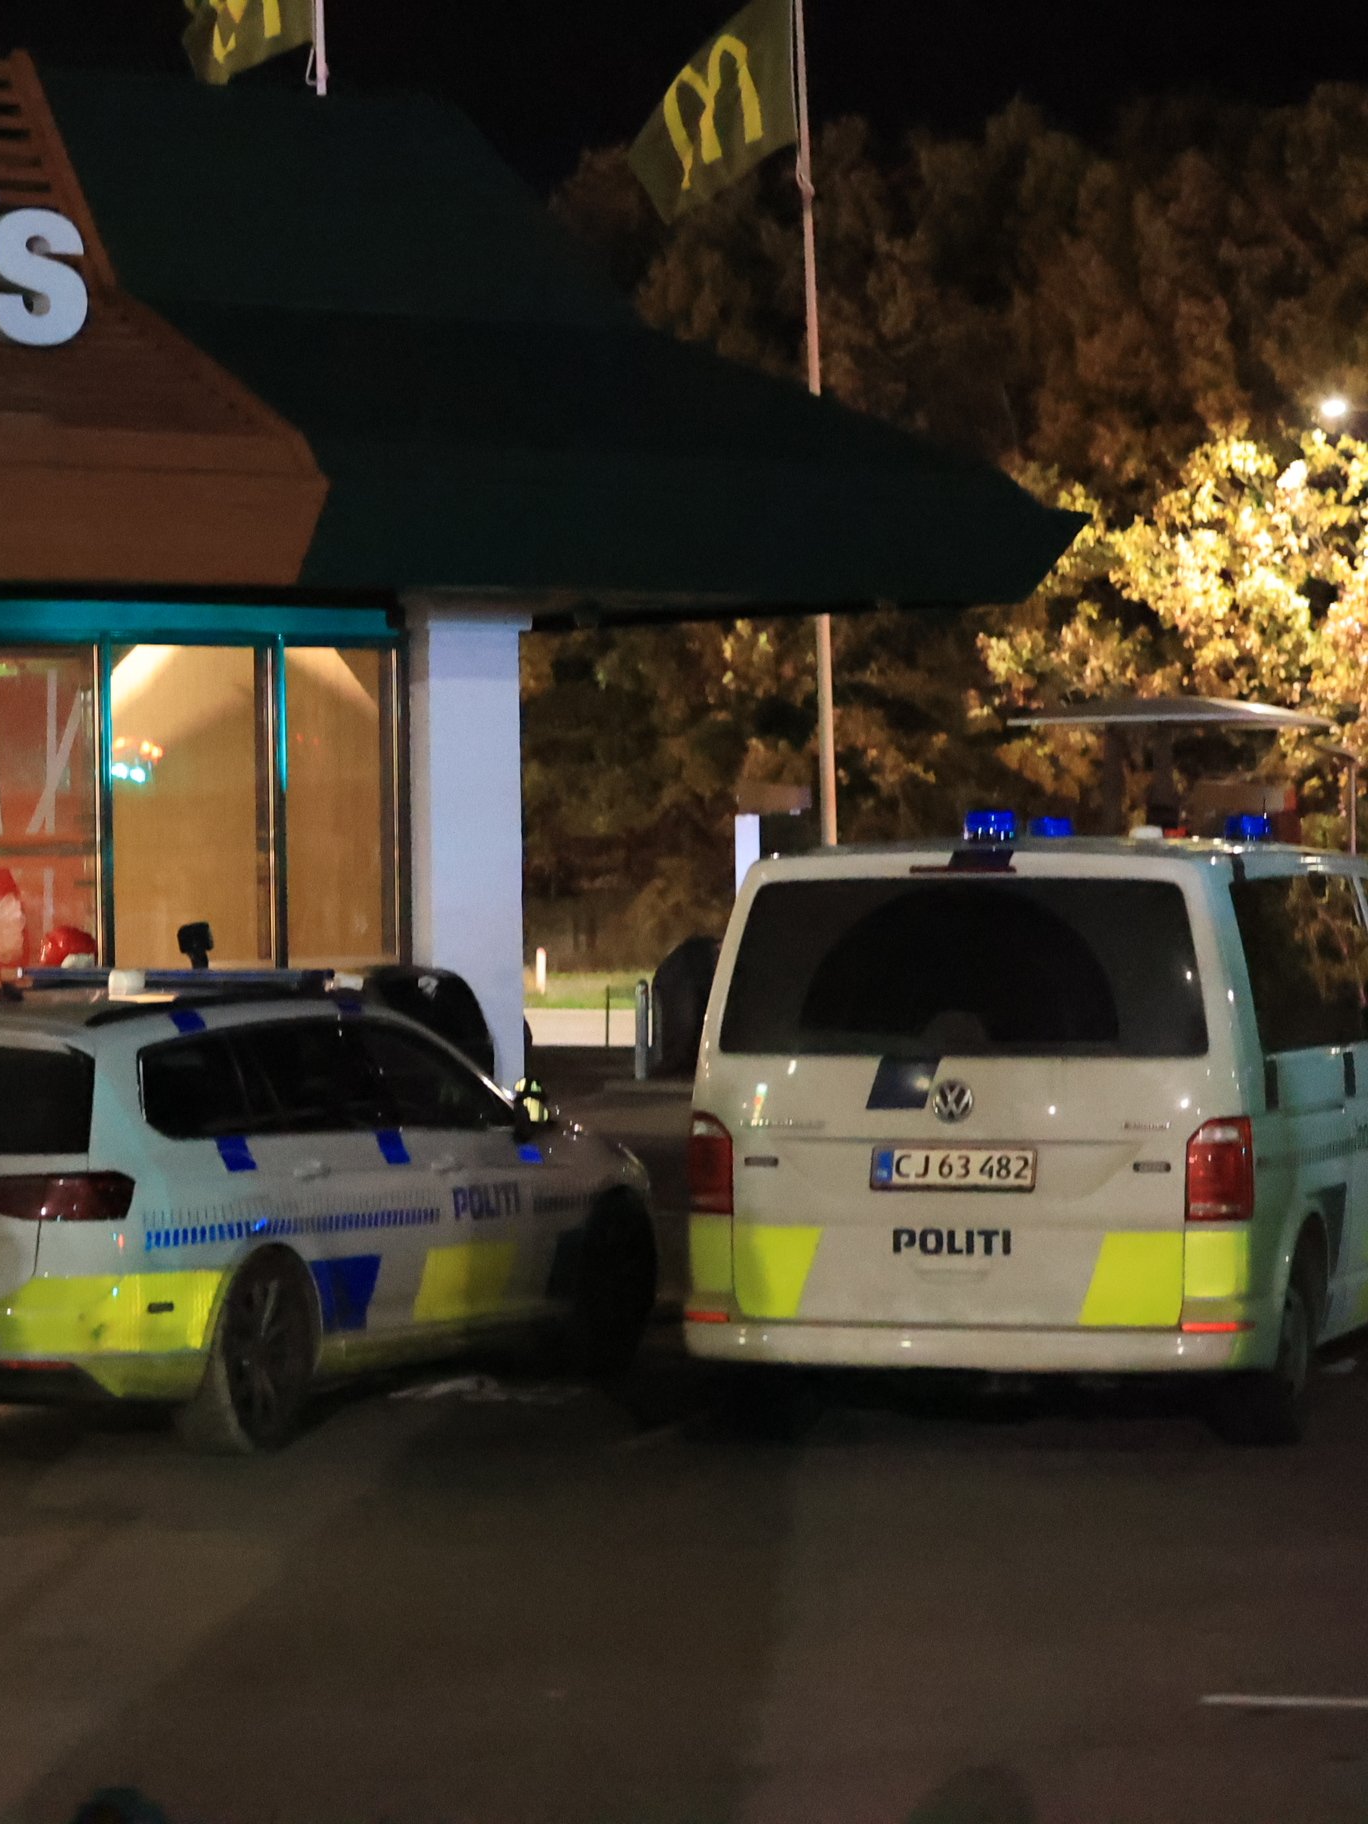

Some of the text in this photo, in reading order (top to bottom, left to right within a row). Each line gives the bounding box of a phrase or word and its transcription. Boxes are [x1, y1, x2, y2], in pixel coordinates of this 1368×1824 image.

[895, 1154, 1029, 1180] CJ 63 482
[452, 1180, 520, 1220] POLITI
[892, 1228, 1012, 1256] POLITI
